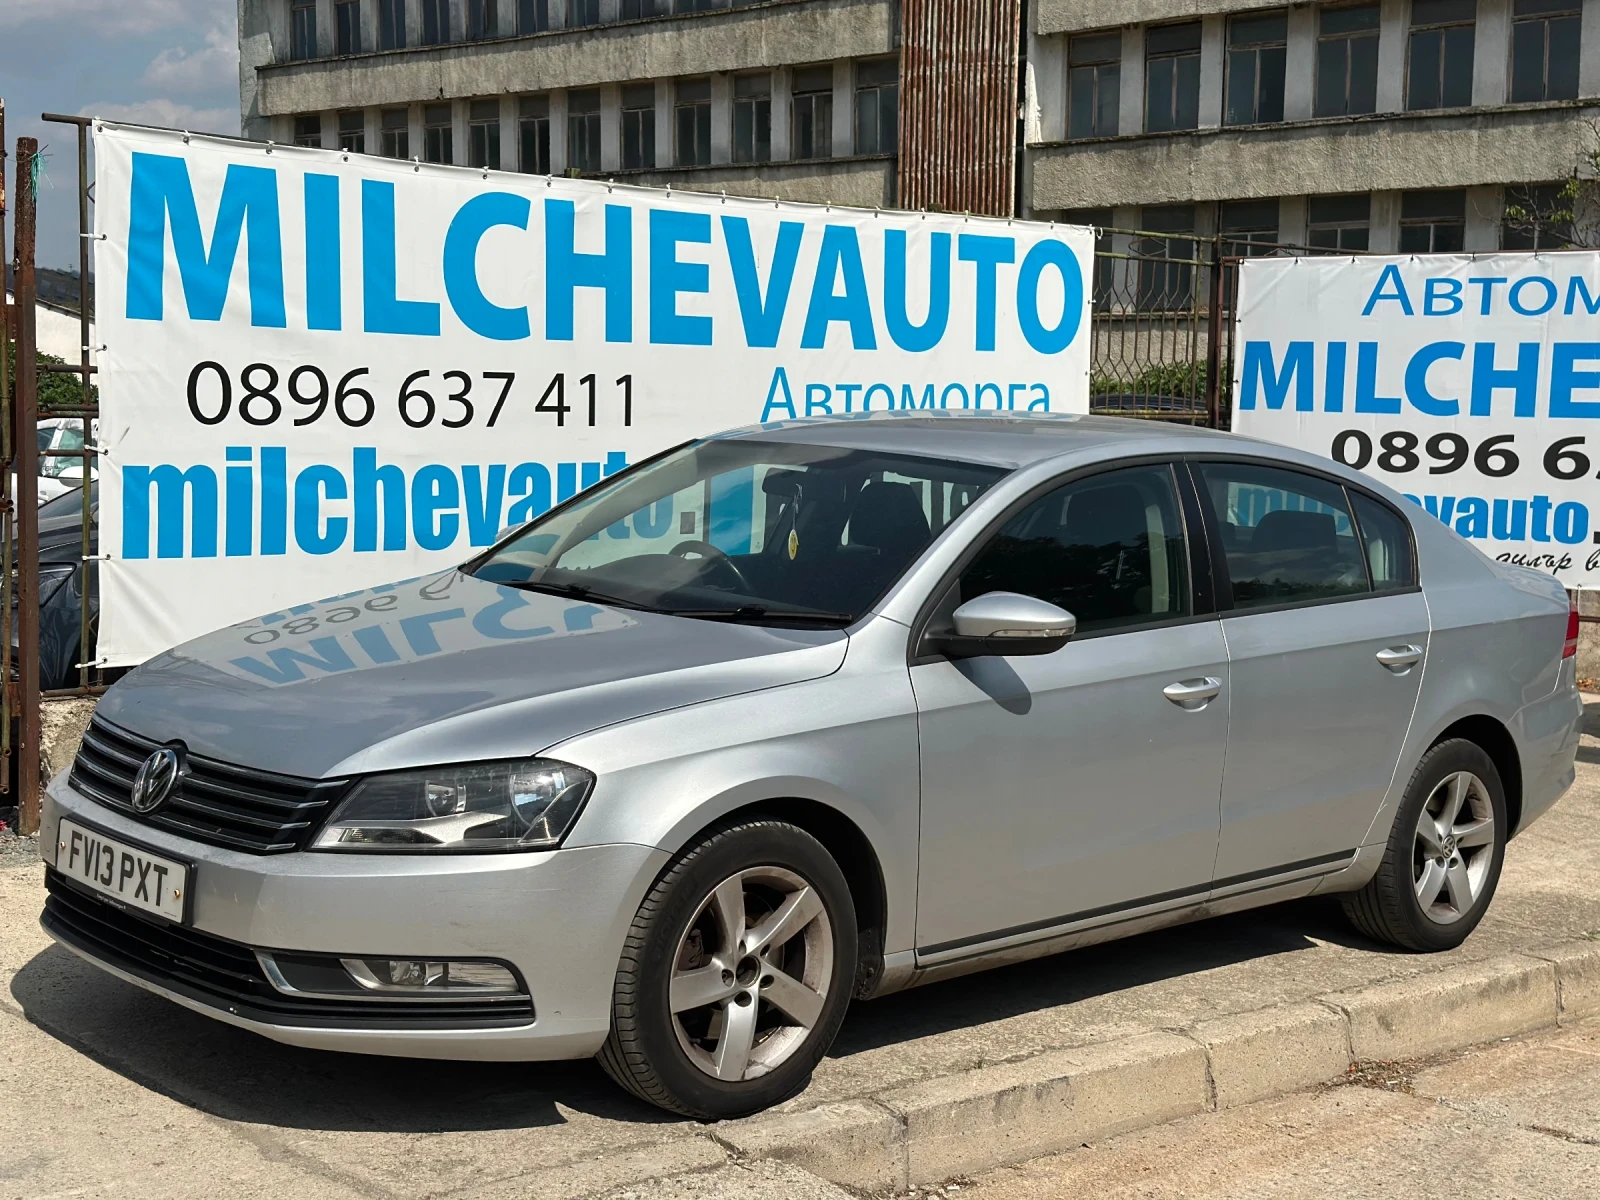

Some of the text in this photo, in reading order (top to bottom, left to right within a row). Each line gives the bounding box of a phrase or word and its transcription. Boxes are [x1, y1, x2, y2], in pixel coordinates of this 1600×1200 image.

[126, 153, 1083, 354] MILCHEVAUTO
[187, 361, 632, 428] 0896 637 411
[1240, 342, 1600, 418] MILCHE
[1331, 430, 1600, 481] 0896 6
[69, 830, 168, 907] FV13 PXT
